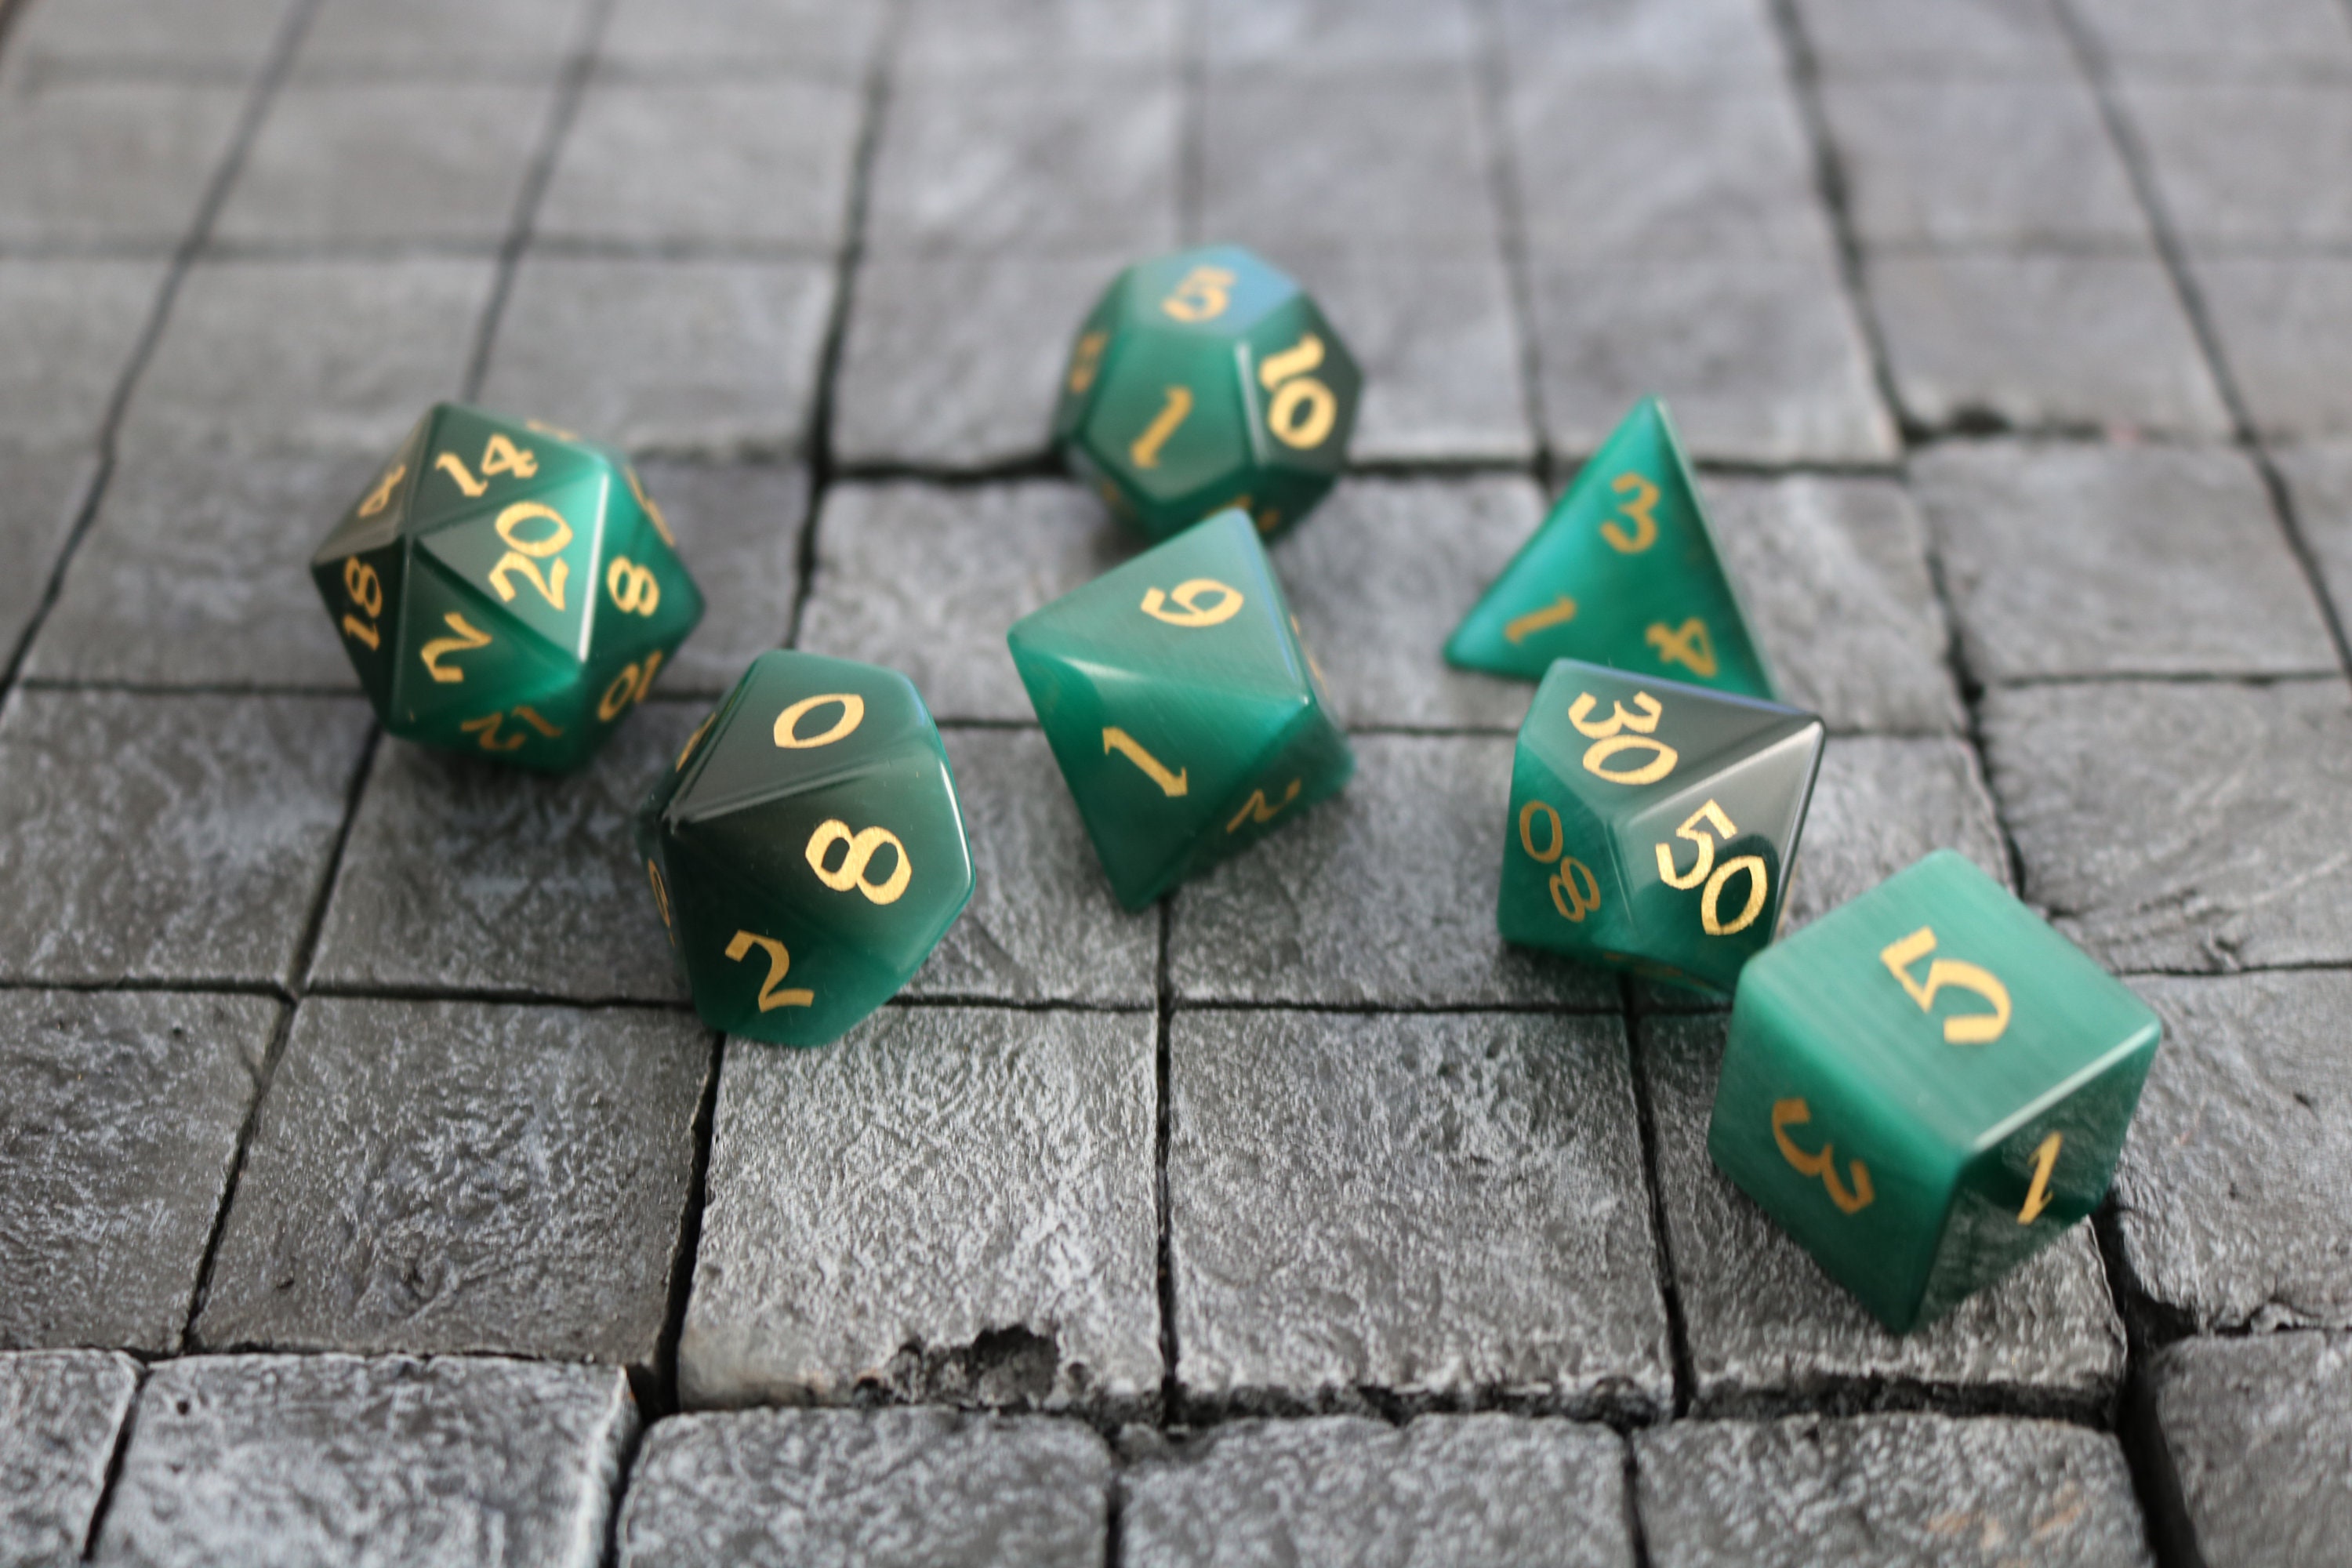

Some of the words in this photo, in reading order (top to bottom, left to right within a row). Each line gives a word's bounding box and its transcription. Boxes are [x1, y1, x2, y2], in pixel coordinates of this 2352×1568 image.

[1162, 267, 1236, 322] 5
[1131, 387, 1192, 468] 1
[1260, 332, 1337, 450] 10
[435, 434, 539, 498] 14
[1600, 471, 1661, 554] 3
[488, 501, 573, 612] 20
[607, 557, 660, 617] 8
[343, 555, 383, 651] 18
[1504, 594, 1577, 644] 1
[420, 612, 492, 683] 2
[1646, 618, 1716, 677] 4
[772, 693, 866, 750] 0
[1102, 727, 1189, 797] 1
[1567, 691, 1679, 786] 30
[804, 818, 913, 906] 8
[1519, 800, 1602, 924] 80
[1655, 798, 1769, 937] 50
[724, 929, 815, 1013] 2
[1880, 925, 2012, 1044] 5
[1772, 1098, 1875, 1214] 3
[2016, 1131, 2063, 1225] 1
